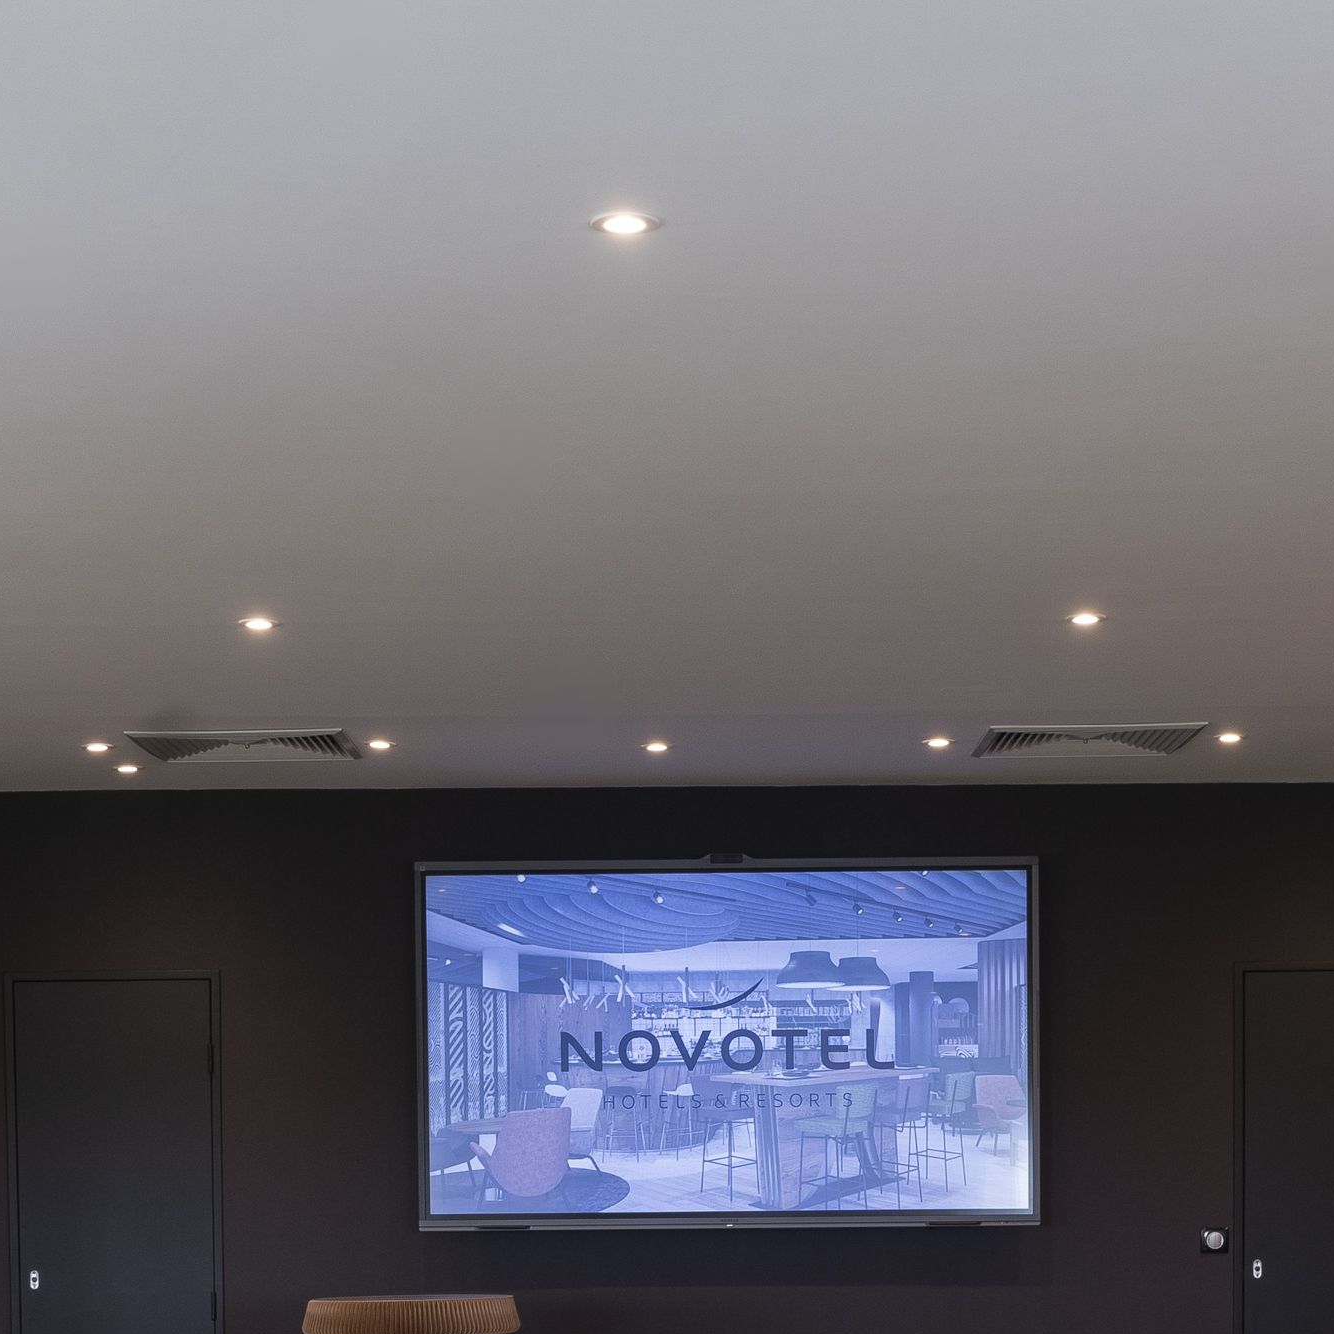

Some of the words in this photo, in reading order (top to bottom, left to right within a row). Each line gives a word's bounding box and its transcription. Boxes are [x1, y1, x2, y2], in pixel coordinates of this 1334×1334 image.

[560, 1028, 896, 1073] NOVOTEL
[603, 1094, 701, 1110] HOTELS
[714, 1093, 727, 1109] &
[739, 1092, 854, 1109] RESORTS
